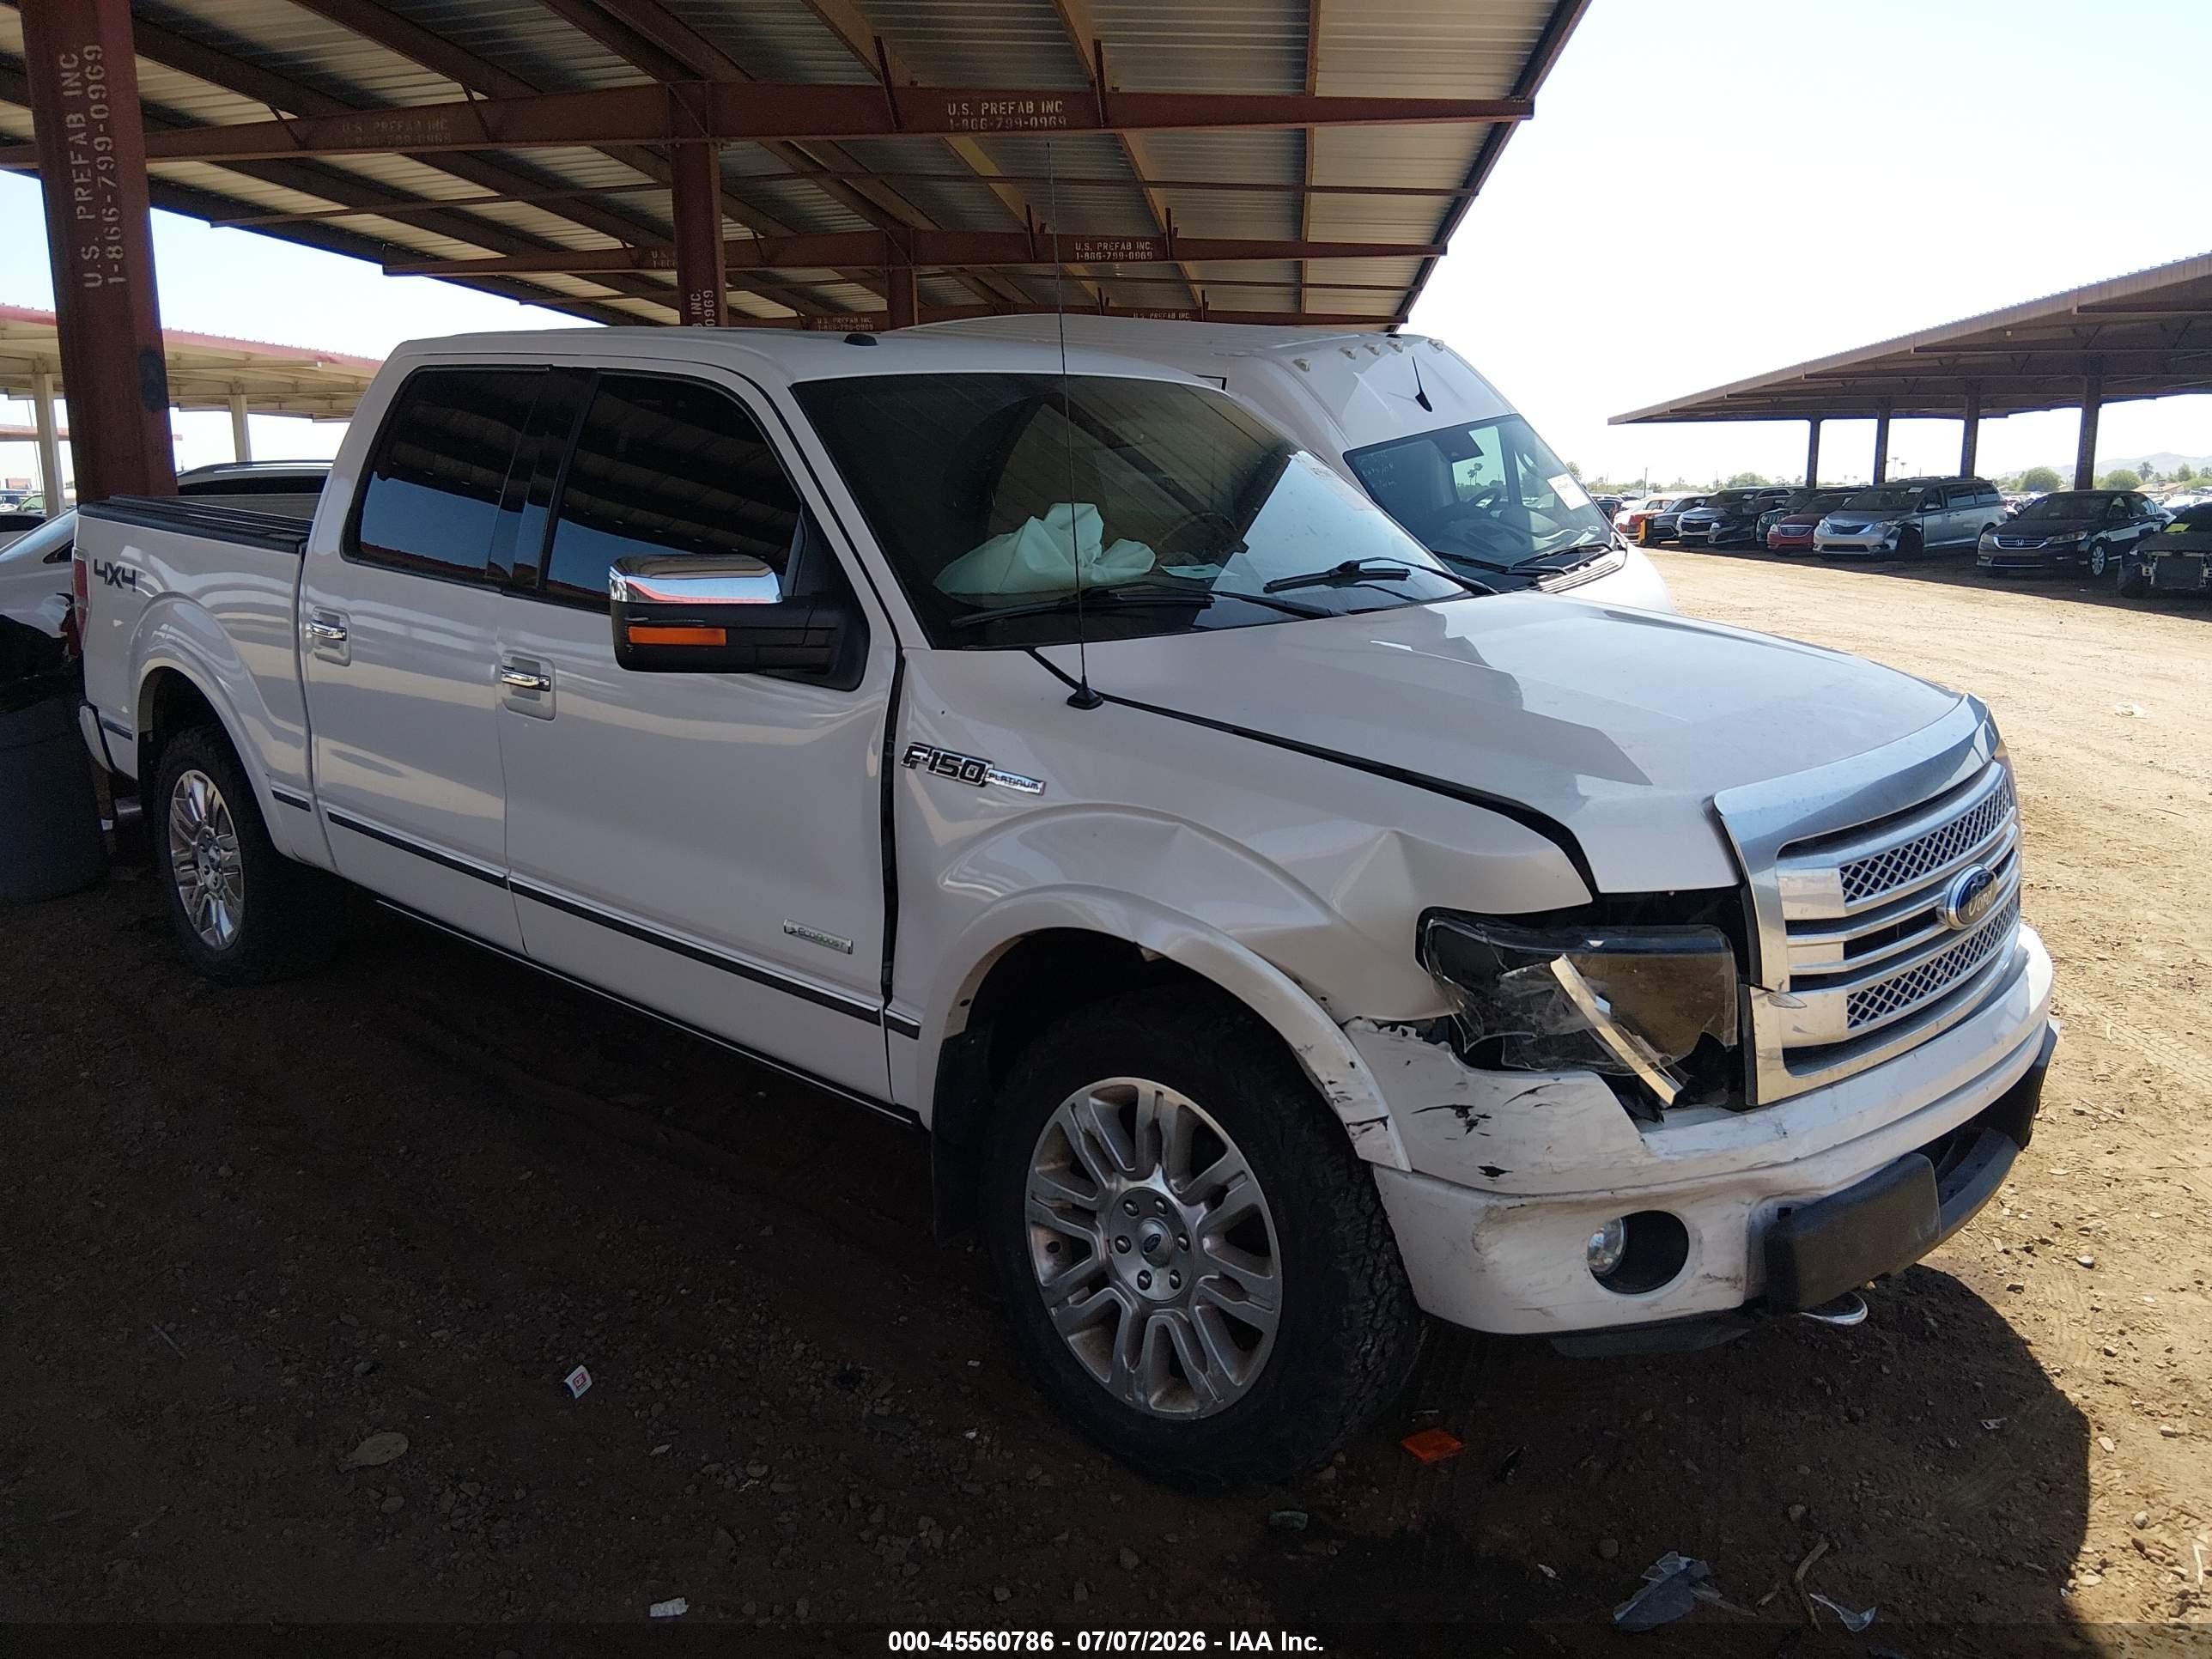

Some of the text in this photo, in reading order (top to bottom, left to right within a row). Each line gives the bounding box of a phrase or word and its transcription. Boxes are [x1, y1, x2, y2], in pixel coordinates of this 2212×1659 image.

[947, 100, 1063, 116] U.S. PREFAB INC
[60, 53, 103, 289] U.S. PREFAB INC
[83, 45, 127, 284] 1-866-799-0969
[1074, 240, 1093, 252] U.S.
[1097, 240, 1132, 251] PREFAB
[1076, 251, 1153, 261] 1-866-799-0969
[1967, 876, 1994, 917] Ford
